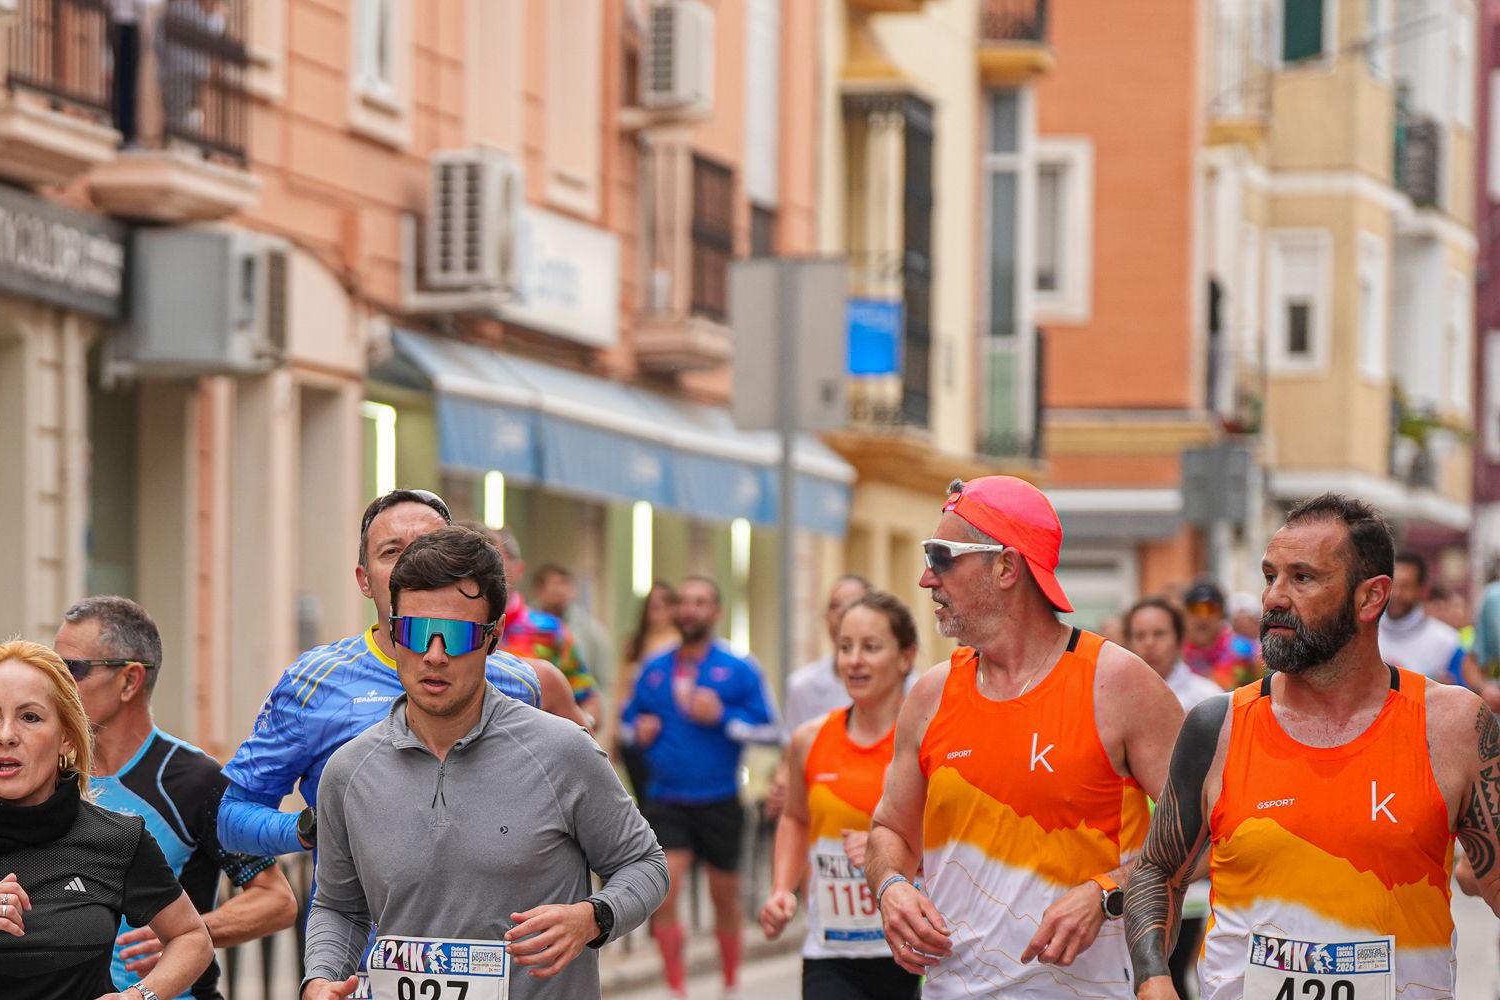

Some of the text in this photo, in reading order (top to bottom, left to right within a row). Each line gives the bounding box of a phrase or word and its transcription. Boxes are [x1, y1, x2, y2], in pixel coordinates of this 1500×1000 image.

[947, 749, 972, 760] GSPORT
[1257, 798, 1295, 810] GSPORT
[385, 941, 426, 972] 21K
[1266, 939, 1309, 972] 21K
[451, 963, 469, 972] 2026
[1336, 963, 1355, 972] 2026
